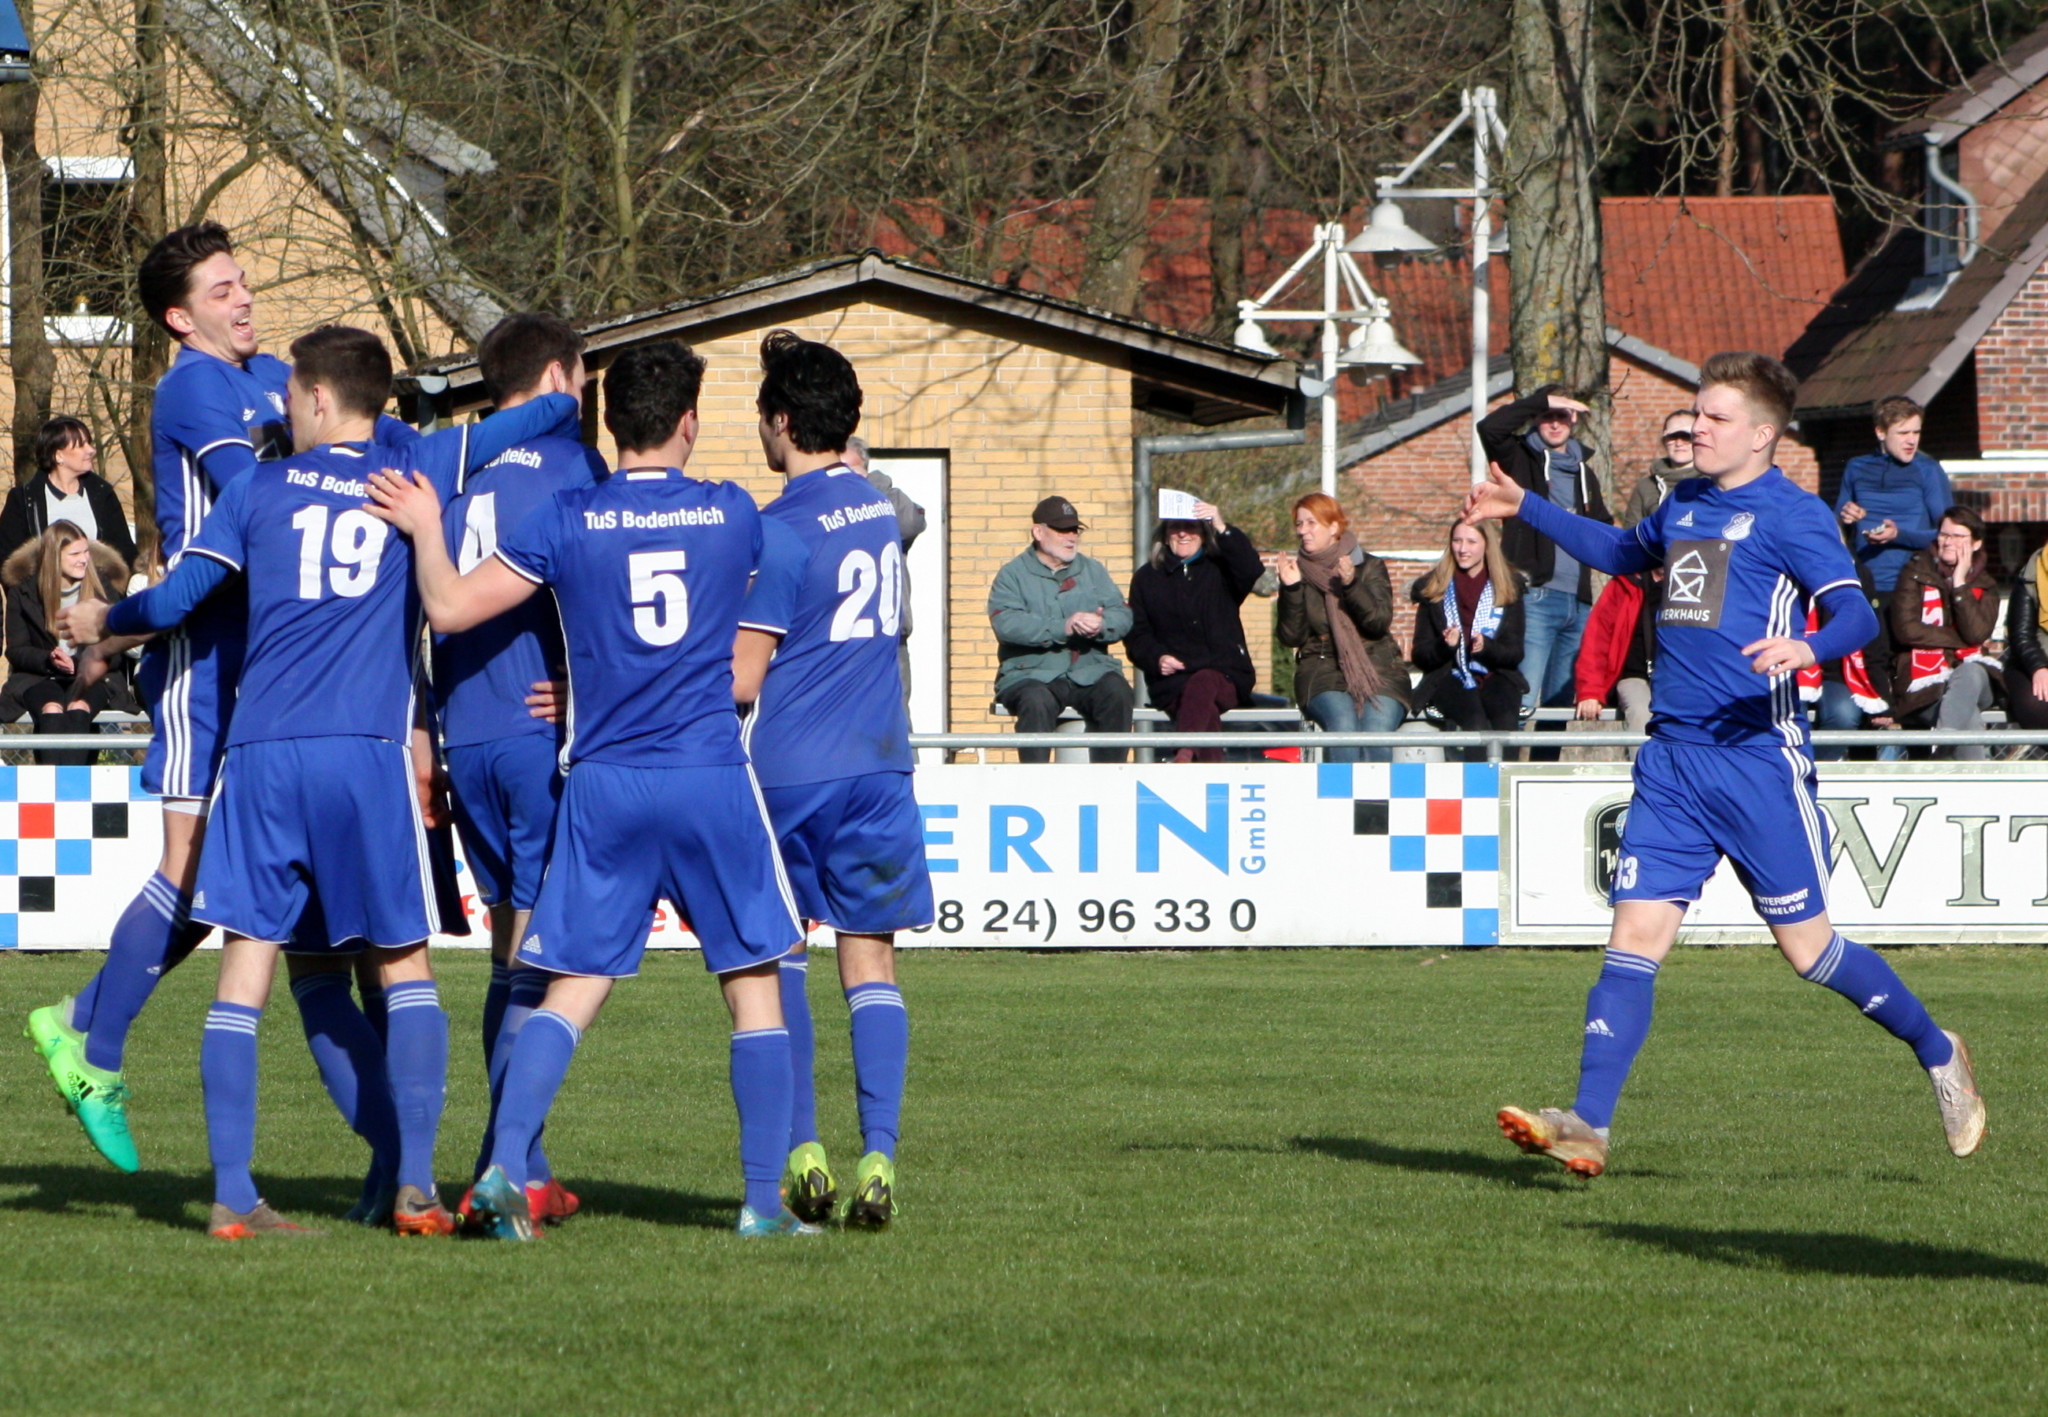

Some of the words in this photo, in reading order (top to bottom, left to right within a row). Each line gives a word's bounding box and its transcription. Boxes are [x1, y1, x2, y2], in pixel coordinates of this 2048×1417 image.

[286, 469, 319, 487] TuS
[584, 511, 617, 529] TuS
[622, 507, 724, 528] Bodenteich
[292, 505, 389, 599] 19
[459, 492, 496, 576] 4
[818, 509, 846, 532] TuS
[629, 551, 688, 646] 5
[830, 541, 900, 641] 20
[1240, 784, 1266, 874] GmbH
[982, 898, 1057, 942] 24)
[1078, 899, 1136, 933] 96
[1154, 899, 1211, 933] 33
[1229, 899, 1257, 933] 0
